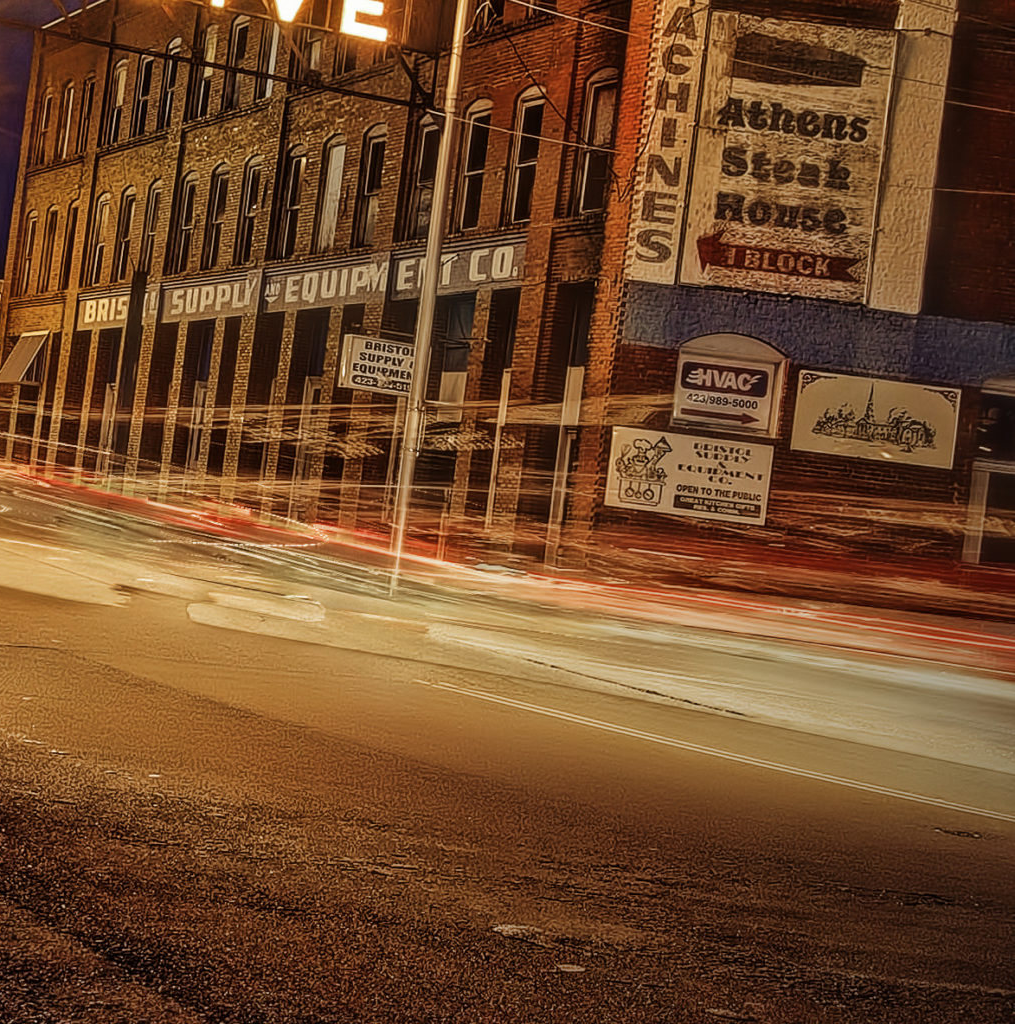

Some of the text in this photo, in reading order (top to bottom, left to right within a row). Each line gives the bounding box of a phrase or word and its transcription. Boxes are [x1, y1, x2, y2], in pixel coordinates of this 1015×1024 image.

[717, 96, 871, 143] Athens
[720, 146, 852, 191] Steak
[714, 191, 848, 235] House
[744, 249, 832, 277] BLOCK
[84, 291, 159, 324] BRISL
[170, 277, 258, 315] SUPPLY
[265, 282, 281, 296] AND
[468, 245, 519, 282] CO.
[359, 352, 404, 367] SUPPLY
[689, 367, 760, 392] HVAC
[686, 393, 759, 410] 423/989-5000
[693, 442, 751, 456] BRISTOL
[695, 450, 751, 463] SUPPLY
[677, 463, 763, 481] EQUIPMENT
[676, 484, 762, 502] OPEN TO THE PUBLIC
